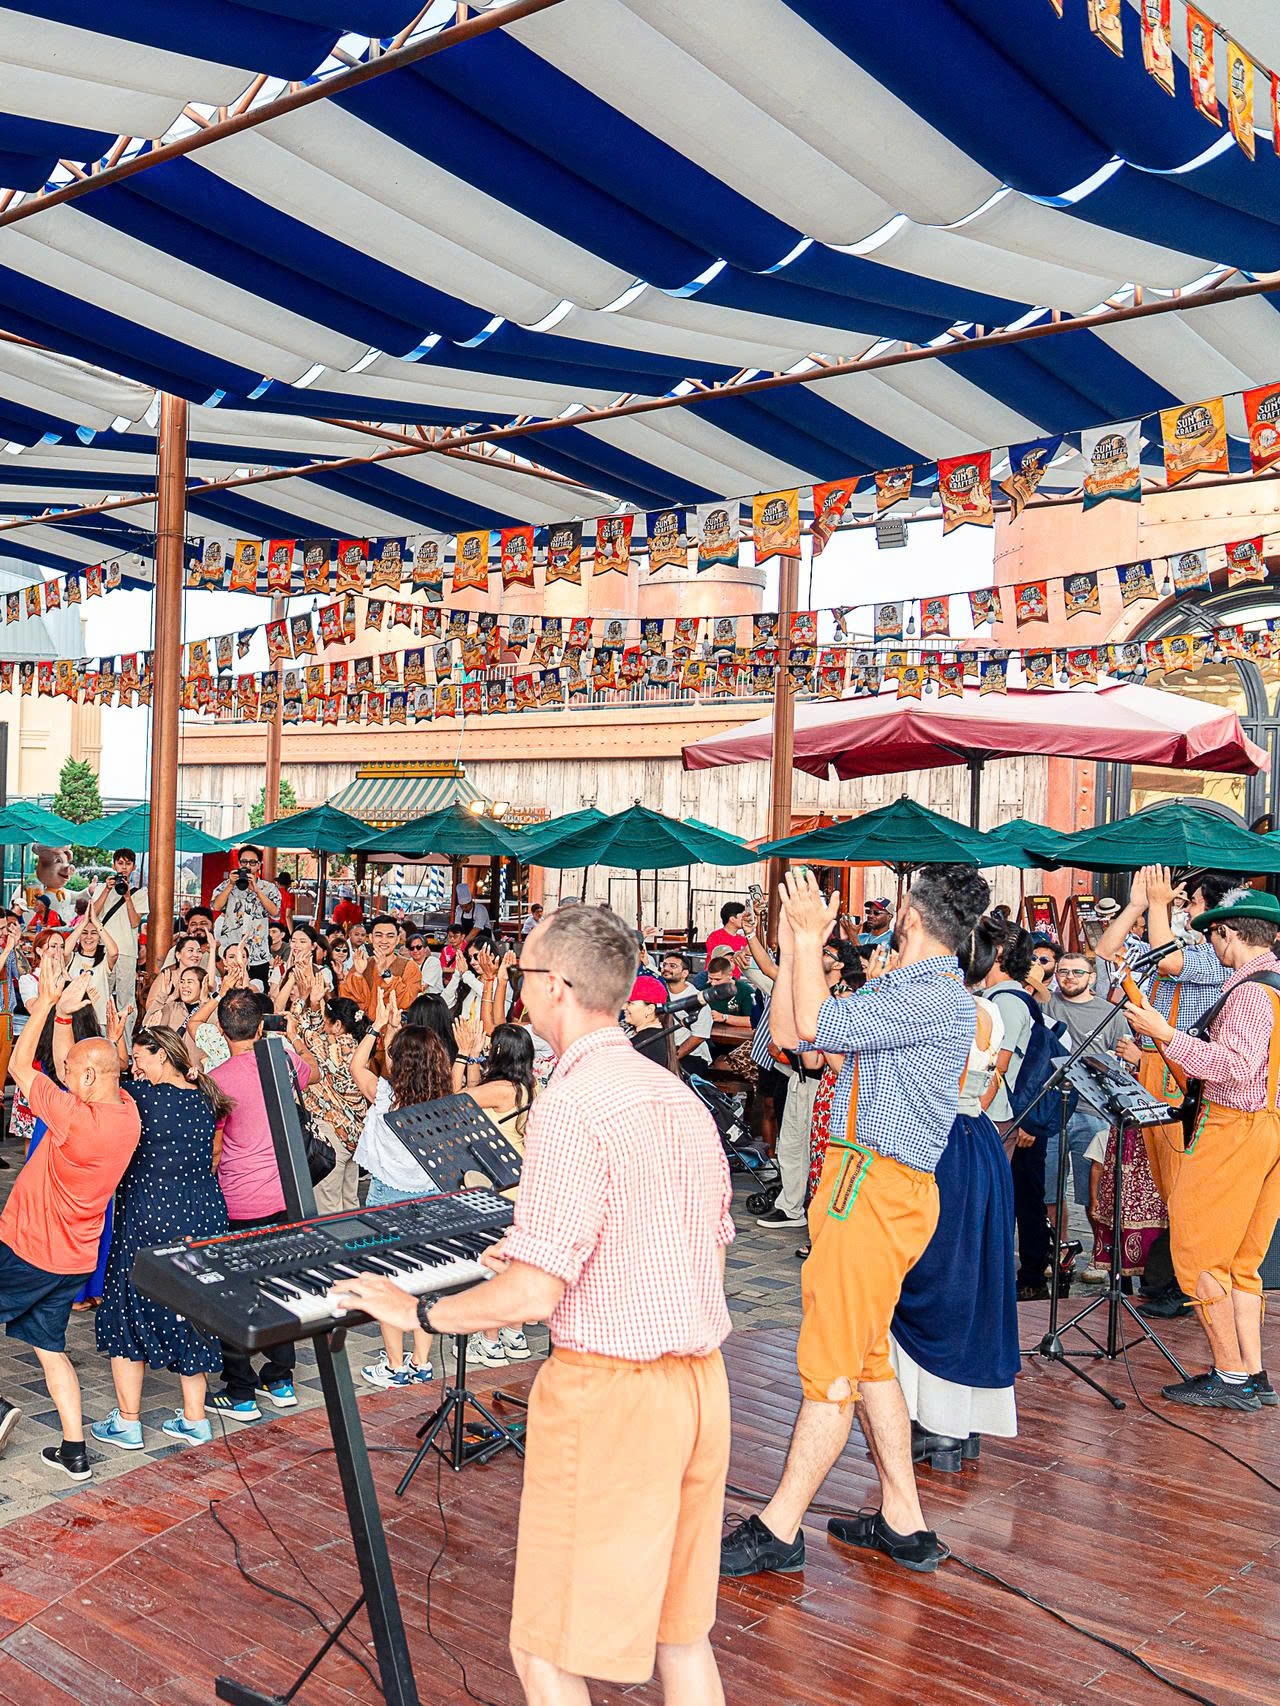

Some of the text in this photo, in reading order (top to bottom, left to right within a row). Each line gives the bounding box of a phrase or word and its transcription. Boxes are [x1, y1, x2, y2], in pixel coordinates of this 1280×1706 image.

[1258, 401, 1278, 414] SUN
[1257, 409, 1280, 421] KRAFT
[1176, 418, 1214, 436] KRAFTBEER
[1177, 415, 1195, 429] SUN
[1094, 443, 1112, 454] SUN
[950, 472, 967, 483] SUN
